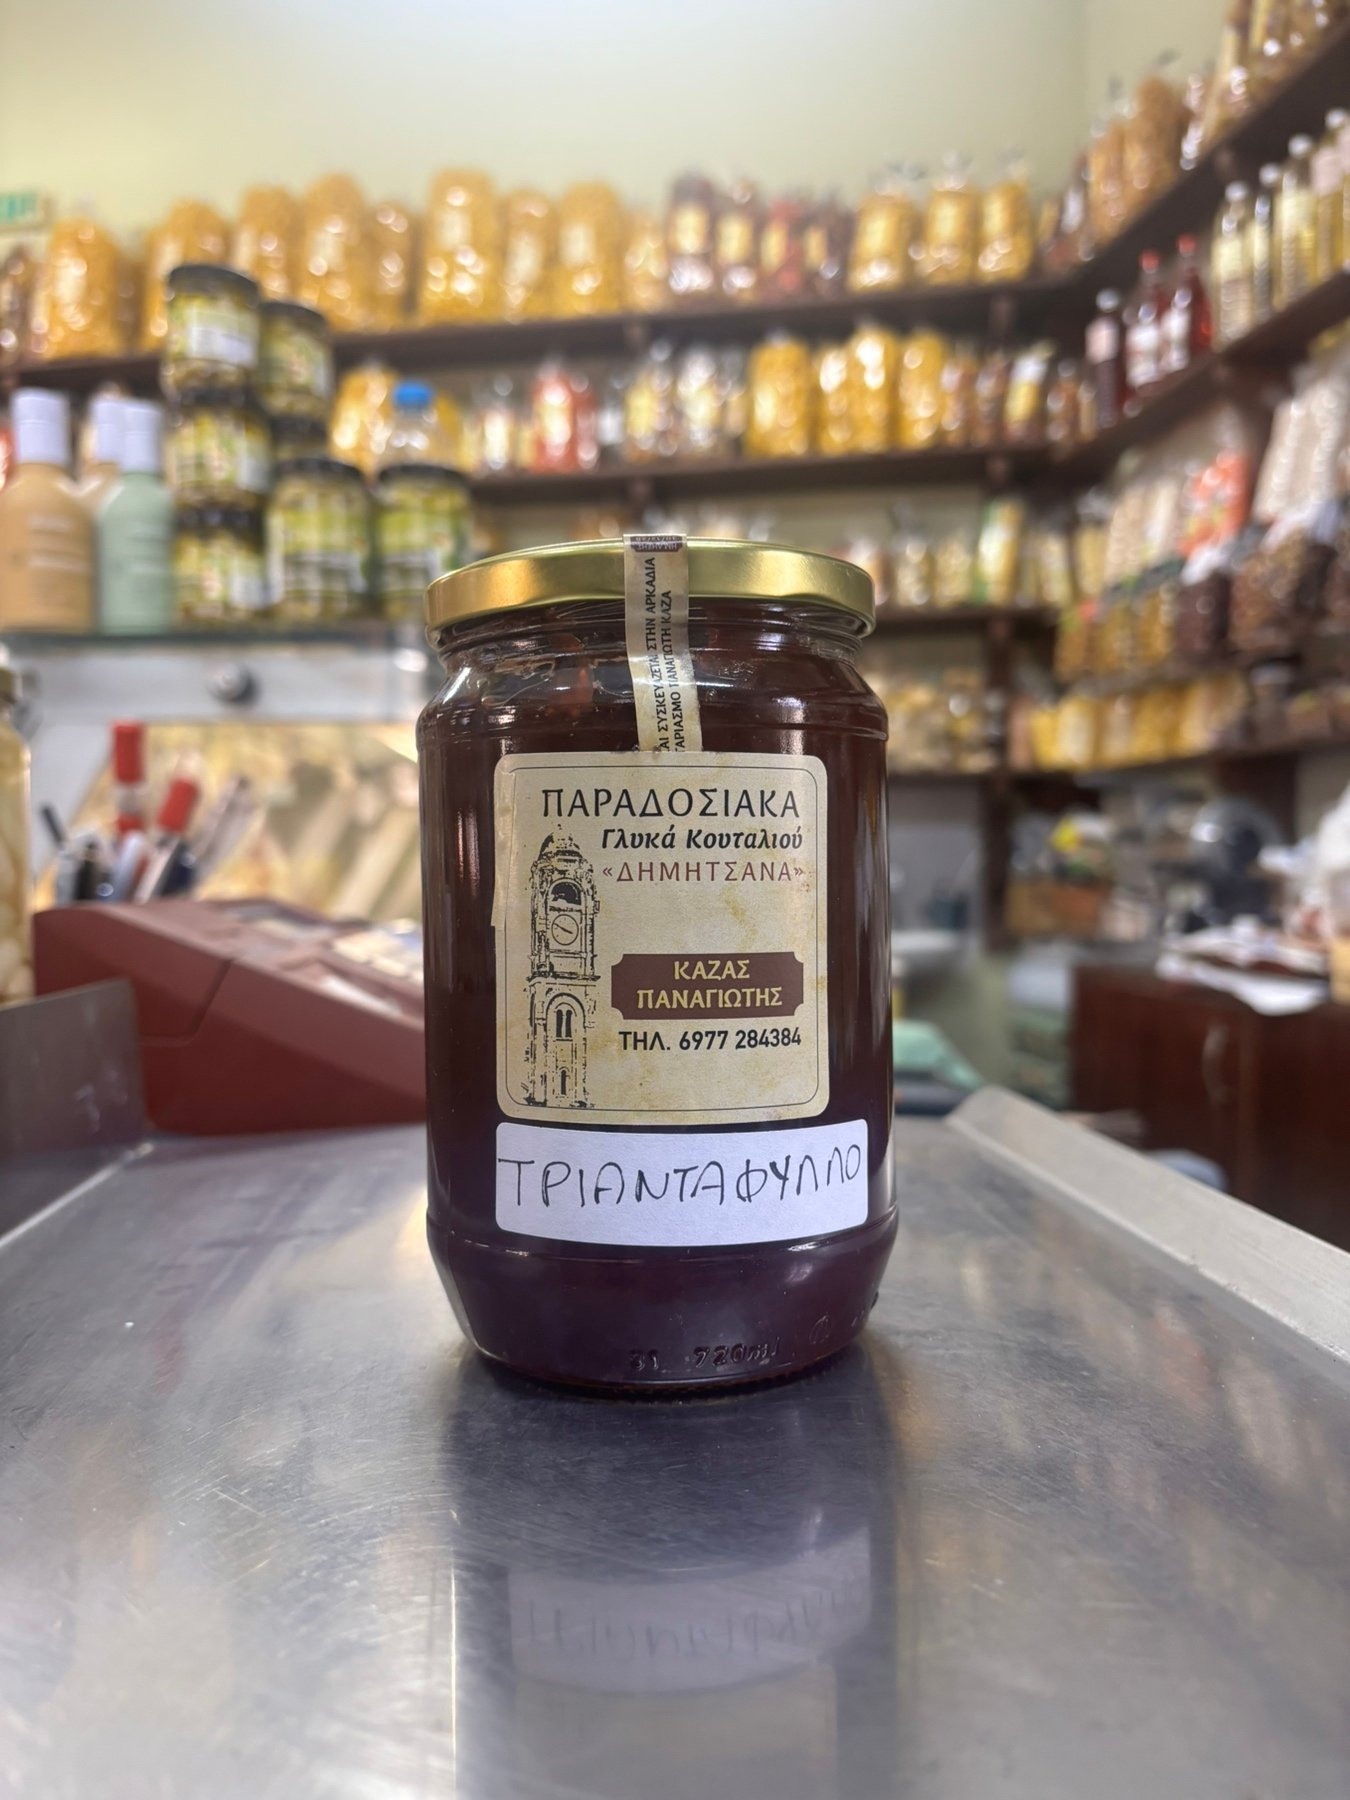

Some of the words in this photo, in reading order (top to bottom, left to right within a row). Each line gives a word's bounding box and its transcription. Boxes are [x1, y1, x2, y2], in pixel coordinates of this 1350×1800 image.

[644, 557, 656, 614] ΑΡΚΑΔΙΑ
[661, 590, 672, 623] ΚΑΖΑ
[645, 617, 657, 653] ΣΤΗΝ
[661, 628, 680, 688] ΠΑΝΑΓΙΩΤΗ
[651, 655, 668, 731] ΣΥΣΚΕΥΑΖΕΤΑΙ
[659, 736, 671, 752] ΑΙ
[542, 788, 800, 817] ΠΑΡΑΔΟΣΙΑΚΑ
[601, 823, 676, 850] Γλυκά
[686, 826, 803, 850] Κουταλιού
[602, 861, 805, 882] «ΔΗΜΗΤΣΑΝΑ»
[674, 959, 750, 981] ΚΑΖΑΣ
[637, 986, 783, 1009] ΠΑΝΑΓΙΩΤΗΣ
[618, 1031, 671, 1051] ΤΗΛ.
[679, 1030, 729, 1051] 6977
[735, 1027, 802, 1050] 284384
